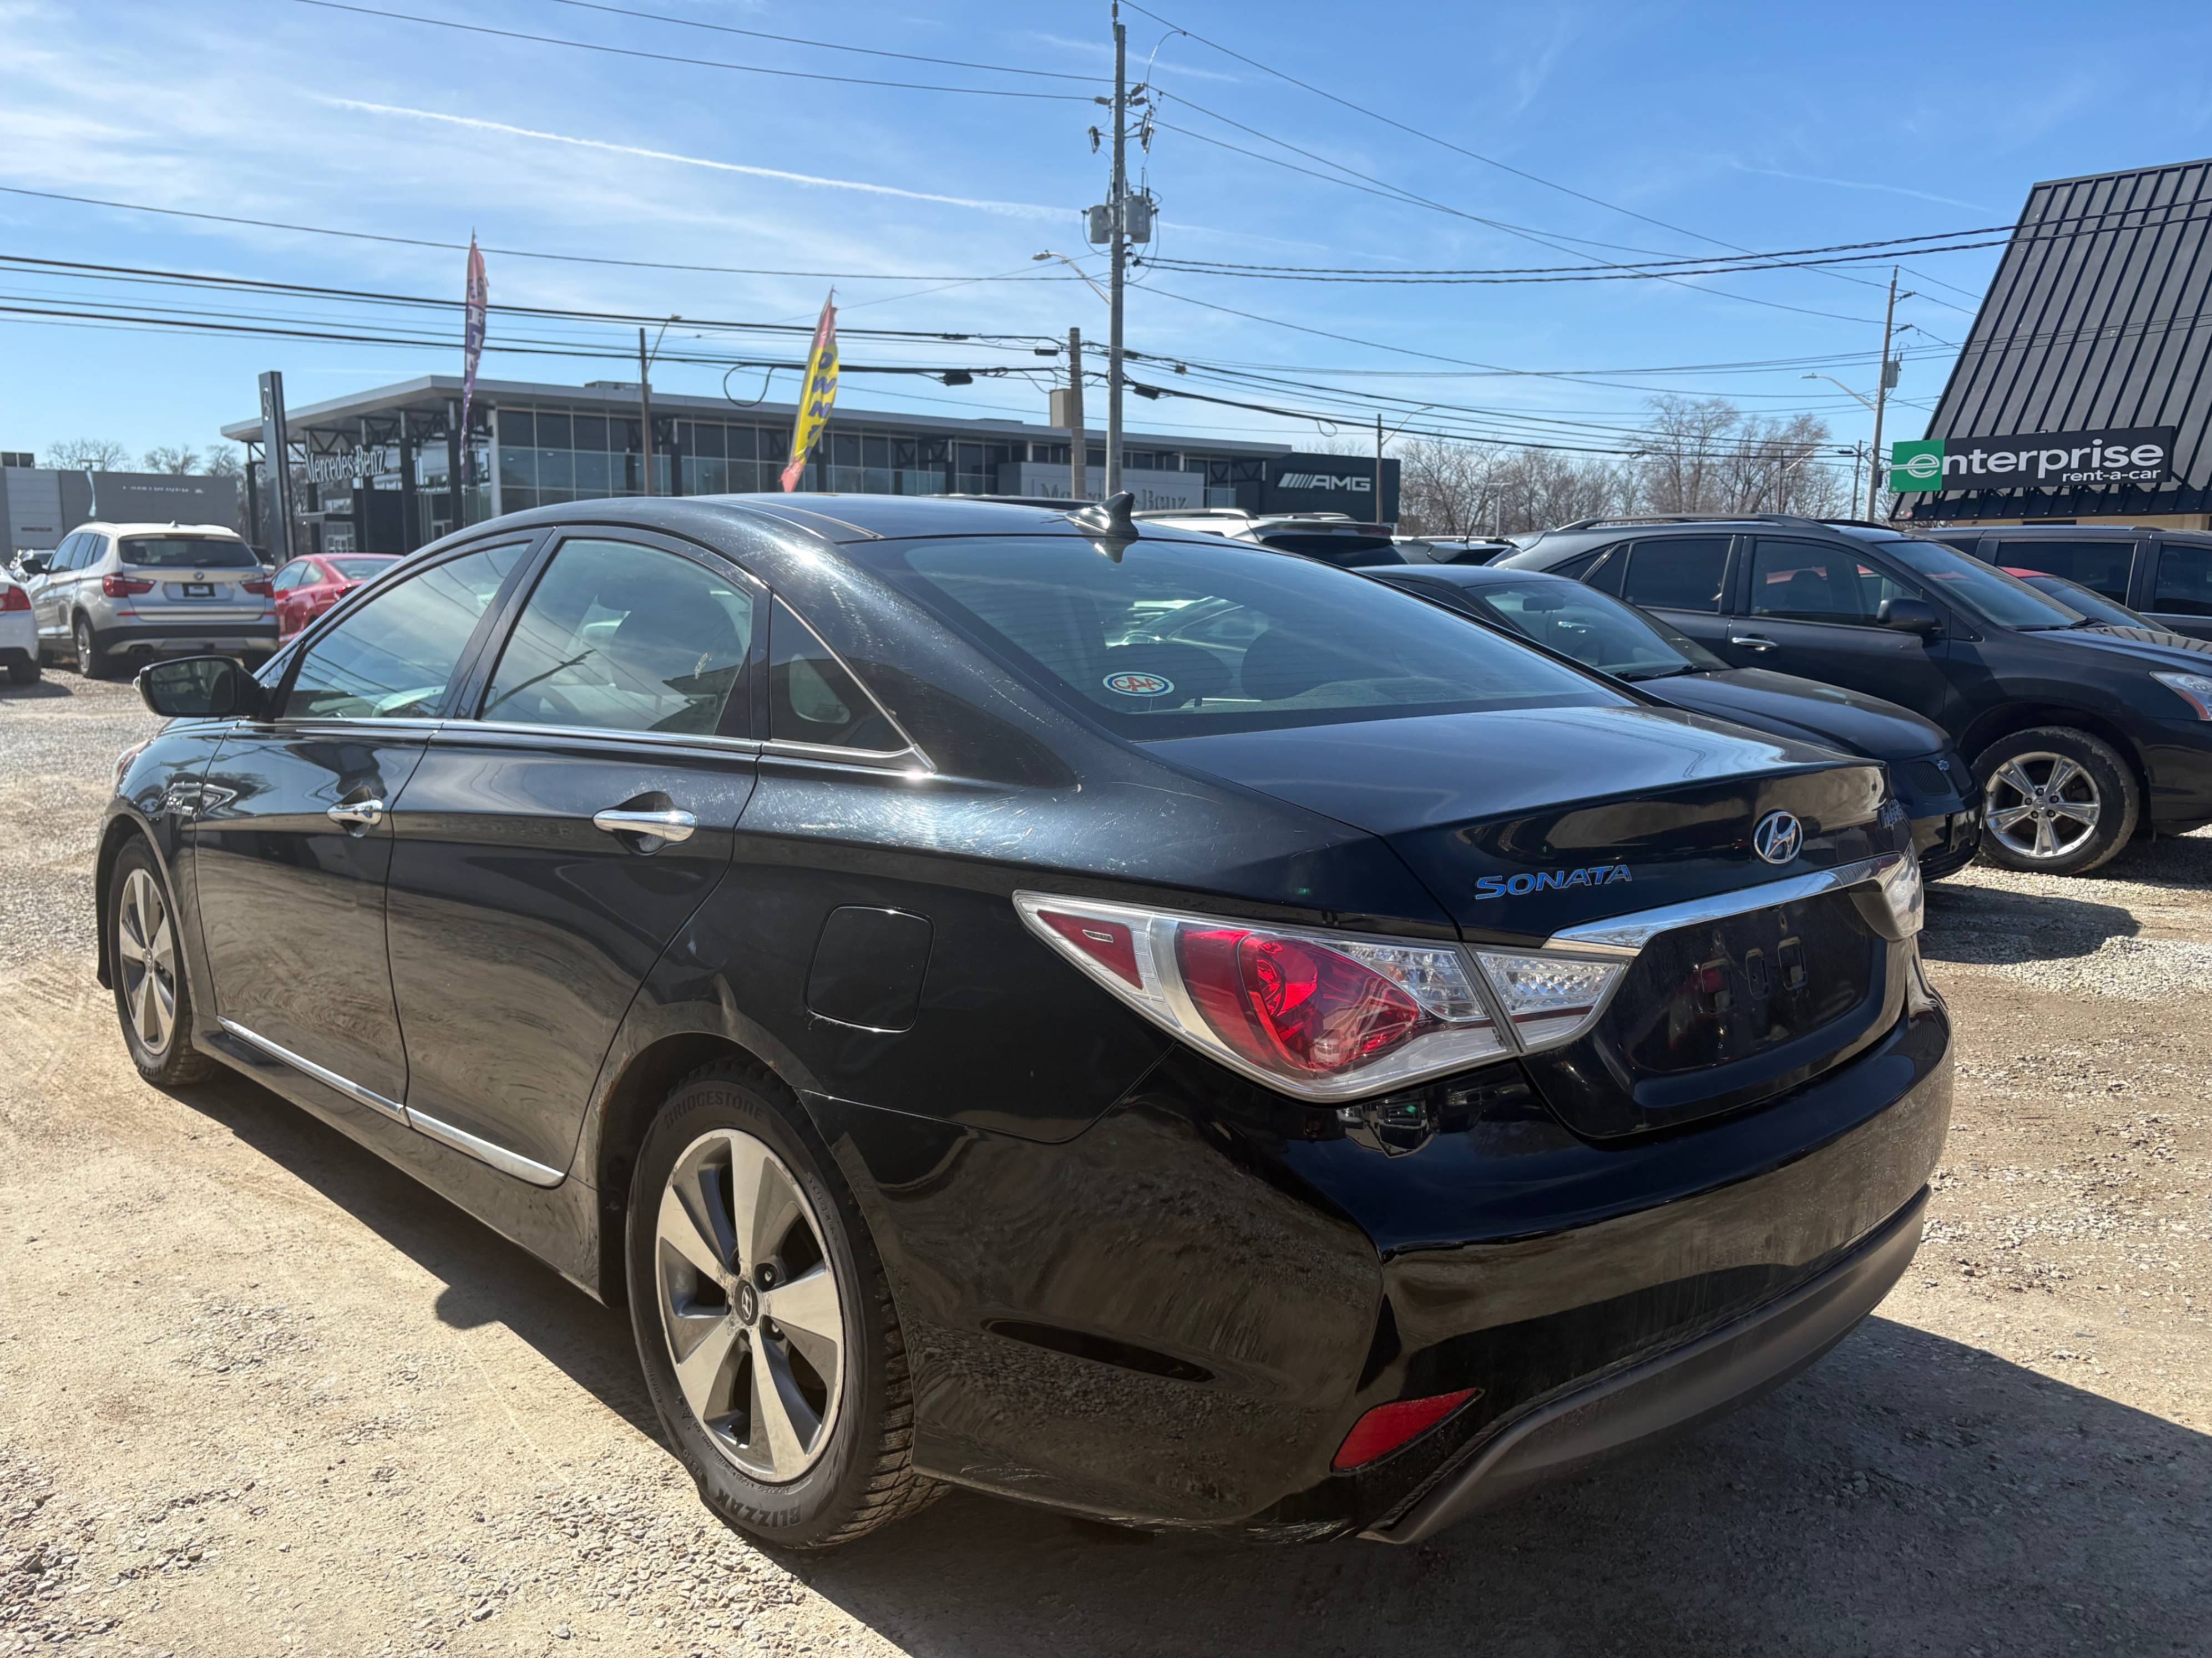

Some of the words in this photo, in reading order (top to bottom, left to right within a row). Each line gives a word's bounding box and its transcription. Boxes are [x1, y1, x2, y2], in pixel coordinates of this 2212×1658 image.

[305, 444, 386, 483] Mercedes-Benz
[1891, 438, 2164, 479] enterprise
[2062, 468, 2162, 482] rent-a-car
[1309, 474, 1371, 492] AMG
[1113, 676, 1163, 692] CAA
[1475, 864, 1632, 900] SONATA
[664, 1090, 765, 1130] BRIDGESTONE
[716, 1487, 802, 1528] BLIZZAK
